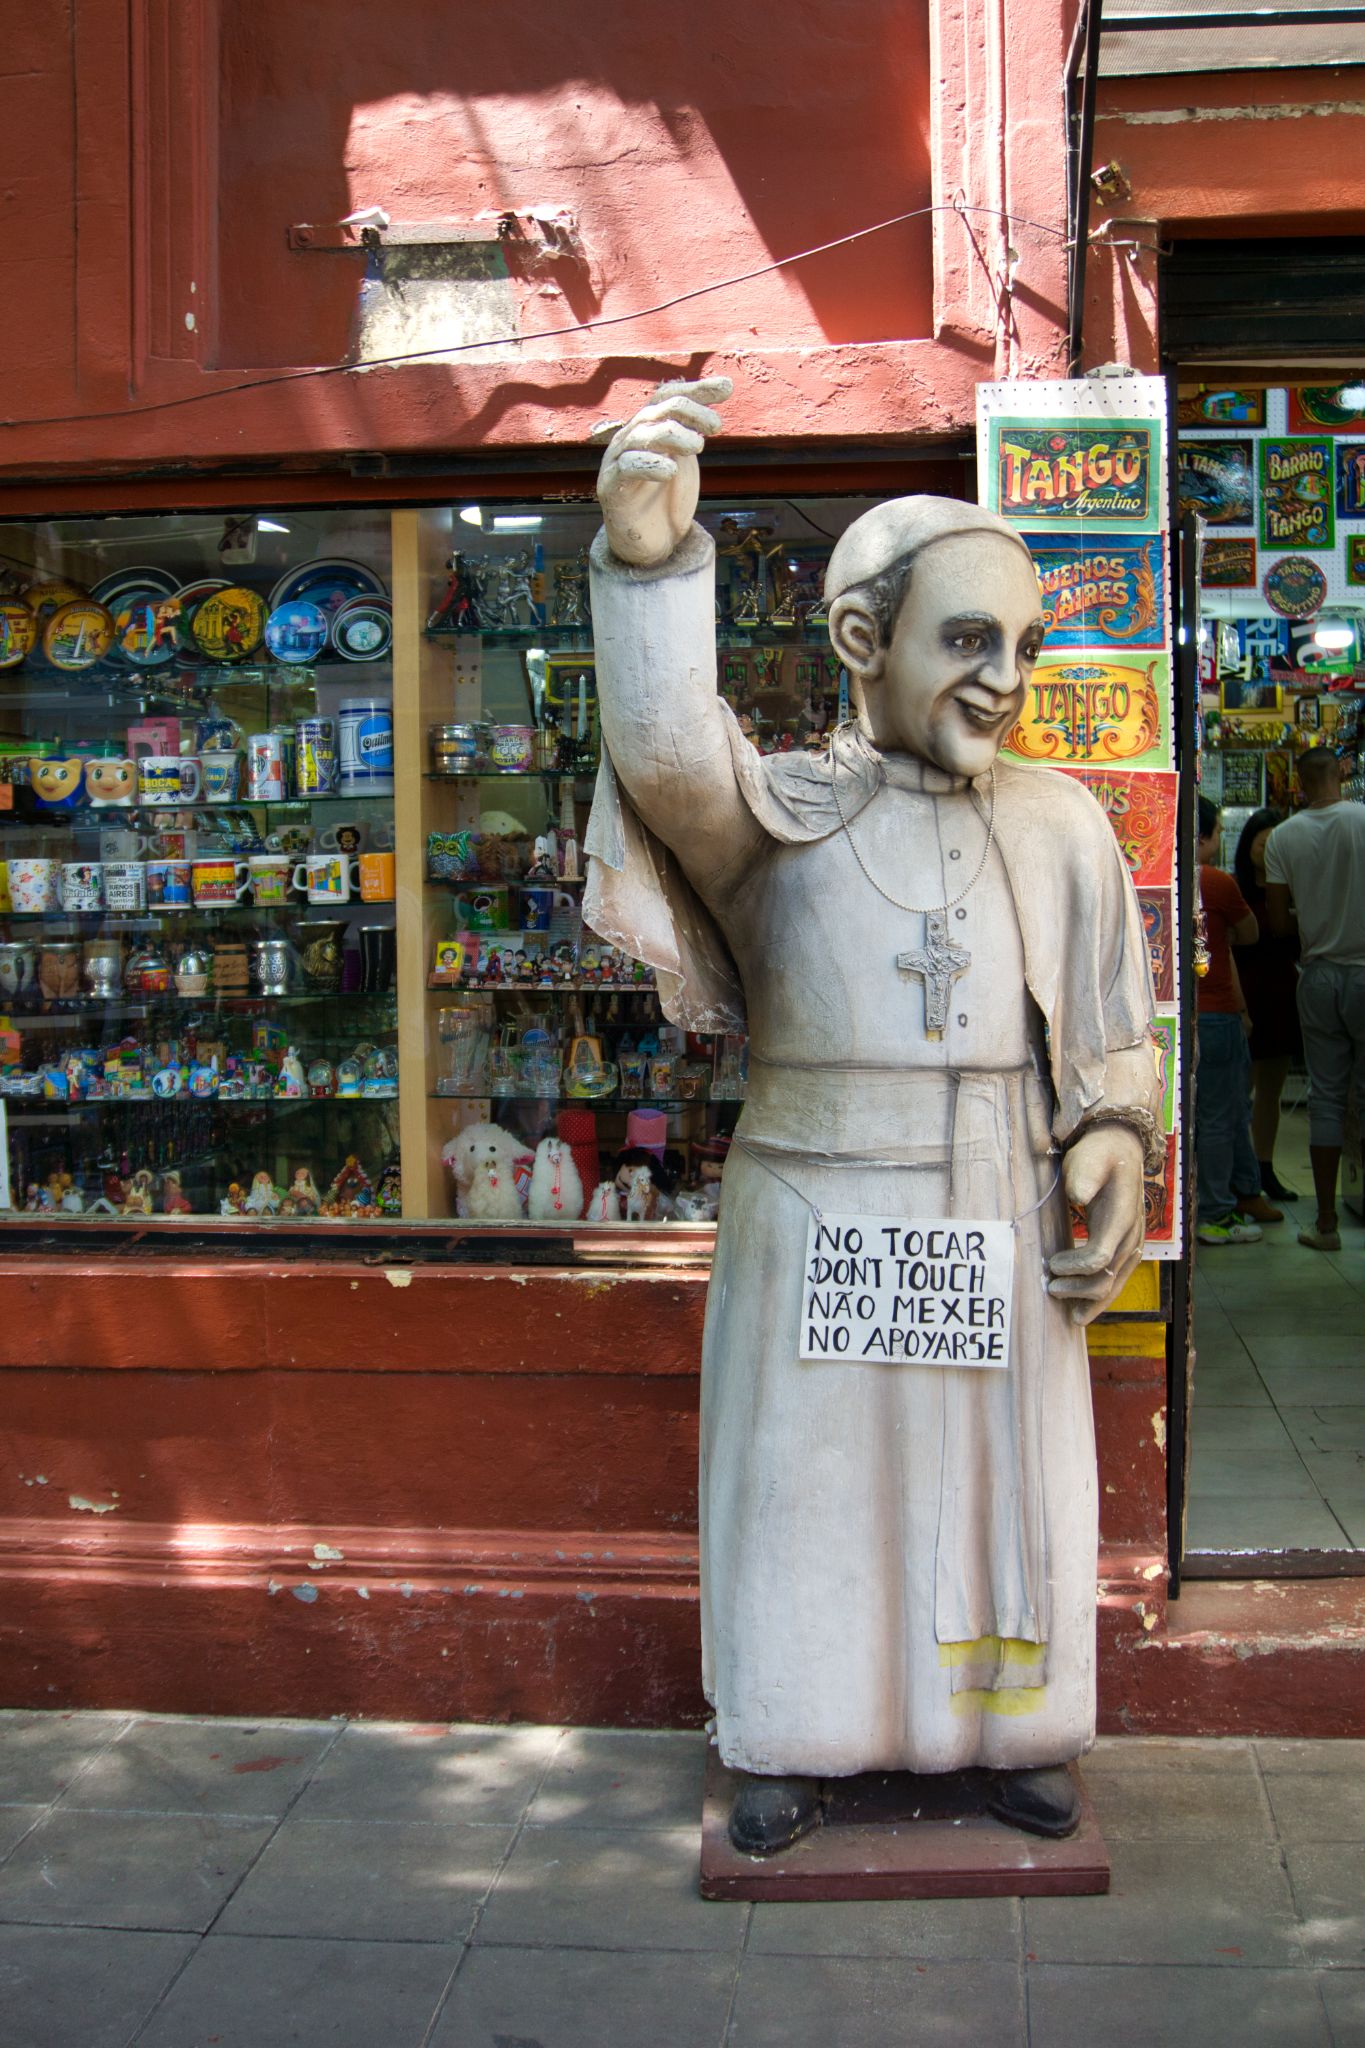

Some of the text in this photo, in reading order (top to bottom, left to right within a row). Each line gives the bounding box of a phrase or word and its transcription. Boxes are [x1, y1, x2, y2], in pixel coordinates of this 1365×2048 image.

[1003, 443, 1141, 503] TANGO
[1270, 451, 1323, 480] BARRIO
[1062, 489, 1141, 516] Argentino
[1270, 507, 1323, 536] TANGO
[1278, 564, 1313, 577] TANGO
[1058, 581, 1129, 619] AIRES
[1030, 681, 1131, 757] TANGO
[814, 1225, 986, 1261] NO TOCAR
[896, 1260, 985, 1293] TOUCH
[808, 1291, 1005, 1328] NÃO MEXER
[808, 1325, 1004, 1360] NO APOYARSE
